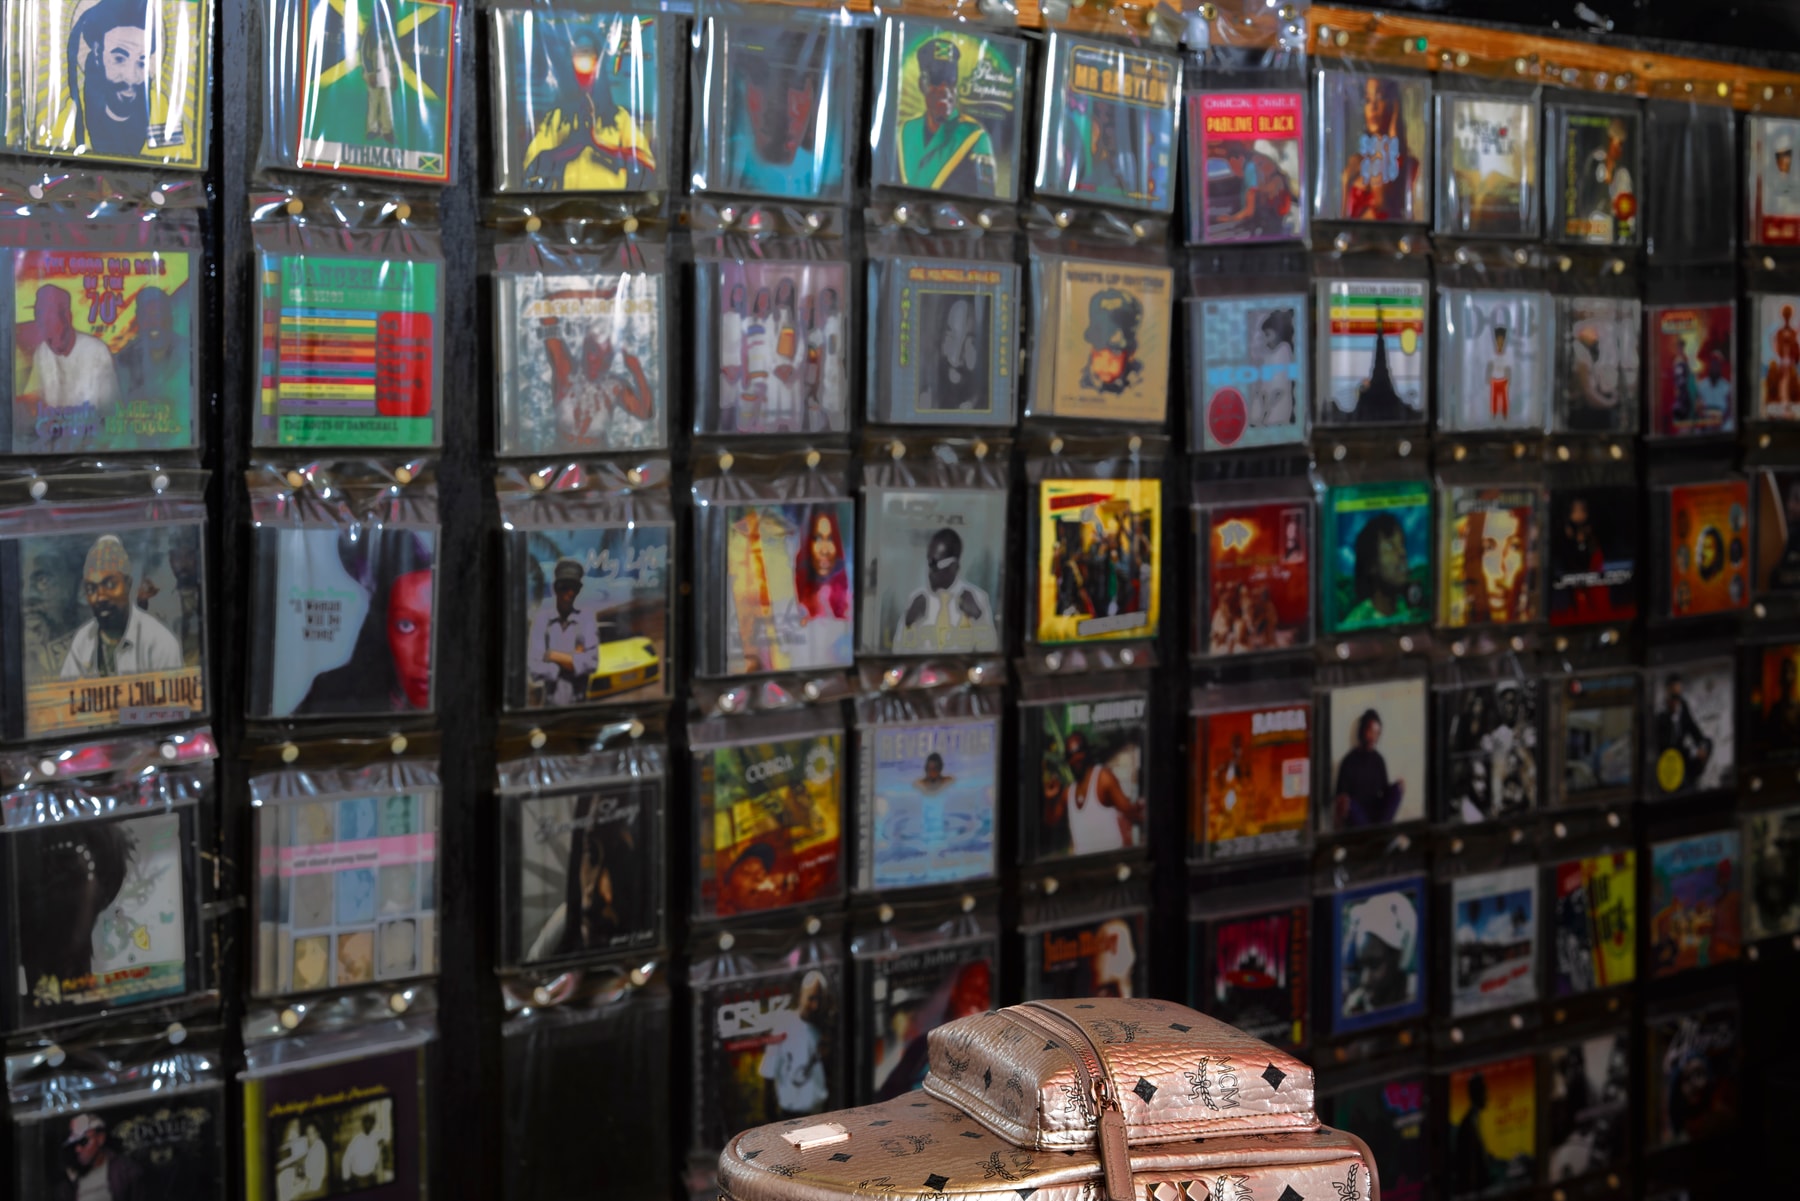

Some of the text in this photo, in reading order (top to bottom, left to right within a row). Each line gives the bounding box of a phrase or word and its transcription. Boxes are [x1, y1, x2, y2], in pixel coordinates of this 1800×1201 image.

[1258, 116, 1295, 132] BLACK
[880, 727, 991, 761] REVELATION
[1212, 1055, 1240, 1110] MCM
